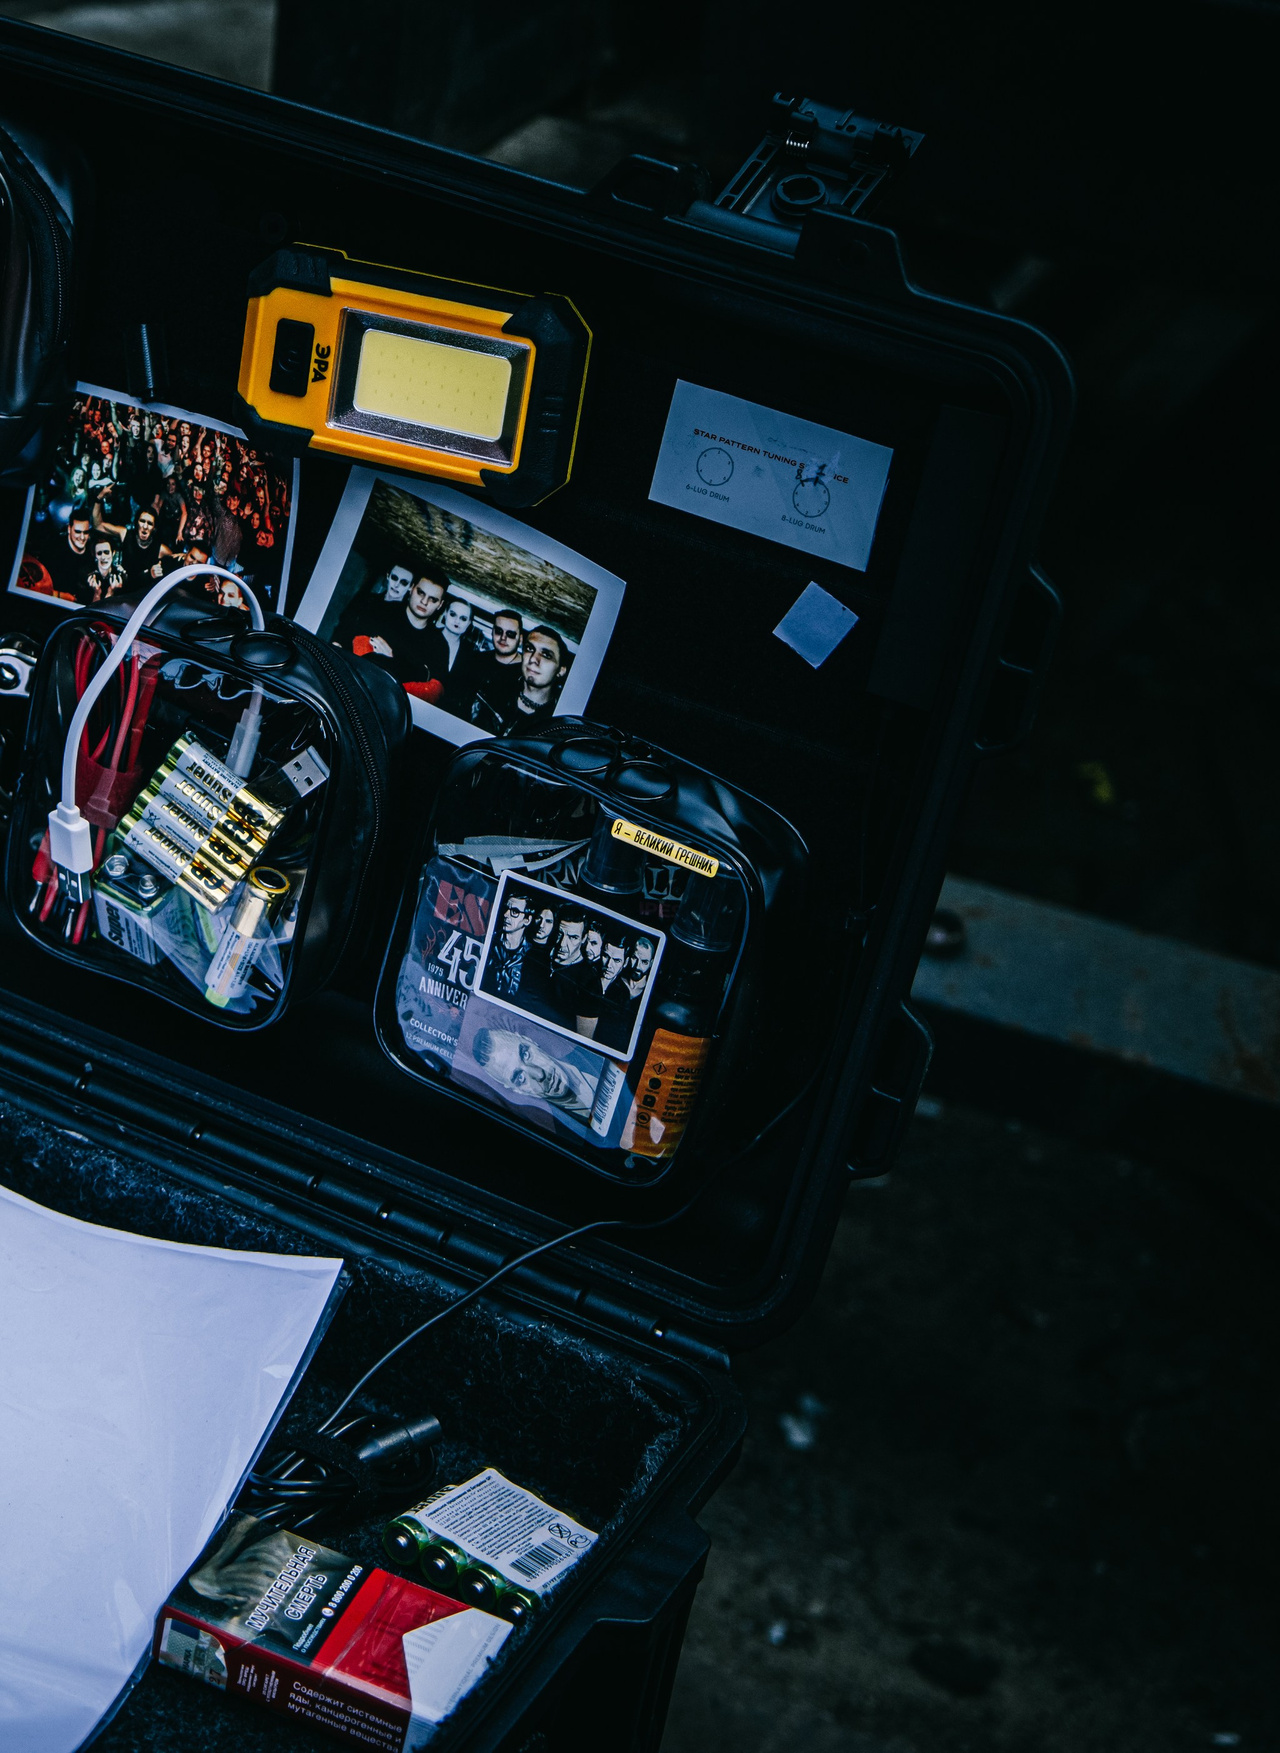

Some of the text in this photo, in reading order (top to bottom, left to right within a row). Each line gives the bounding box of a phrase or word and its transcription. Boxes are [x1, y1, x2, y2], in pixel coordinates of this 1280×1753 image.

[312, 343, 330, 382] ЭРА
[694, 428, 797, 467] STAR PATTERN TUNING
[686, 484, 730, 502] 6-LUG DRUM
[781, 515, 826, 534] 8-LUG DRUM
[182, 759, 234, 803] Super
[201, 757, 221, 774] BATTERY
[171, 775, 225, 821] Super
[231, 796, 267, 829] GP
[158, 798, 210, 843] Super
[219, 814, 255, 847] GP
[140, 824, 192, 868] Super
[206, 836, 242, 867] GP
[614, 822, 714, 874] Я ВЕЛИКИЙ ГРЕШНИК
[187, 860, 224, 893] GP
[428, 962, 444, 977] 1975
[437, 930, 485, 991] 45
[419, 977, 469, 1010] ANNIVER
[406, 1017, 461, 1046] COLLECTOR'S
[410, 1036, 440, 1052] PREMIUM
[676, 1064, 705, 1077] CAUT
[338, 1577, 353, 1592] 200
[349, 1562, 363, 1577] 200
[245, 1544, 307, 1632] МУЧИТЕЛЬНАЯ
[284, 1572, 328, 1622] СМЕРТЬ
[327, 1600, 338, 1608] 8
[330, 1588, 345, 1604] 800
[467, 1641, 490, 1667] PREMIUM
[484, 1622, 502, 1643] DESIGN
[288, 1691, 402, 1744] яды, канцерогенные и
[290, 1680, 404, 1733] Содержит системные
[285, 1701, 400, 1753] мутагенные вещества
